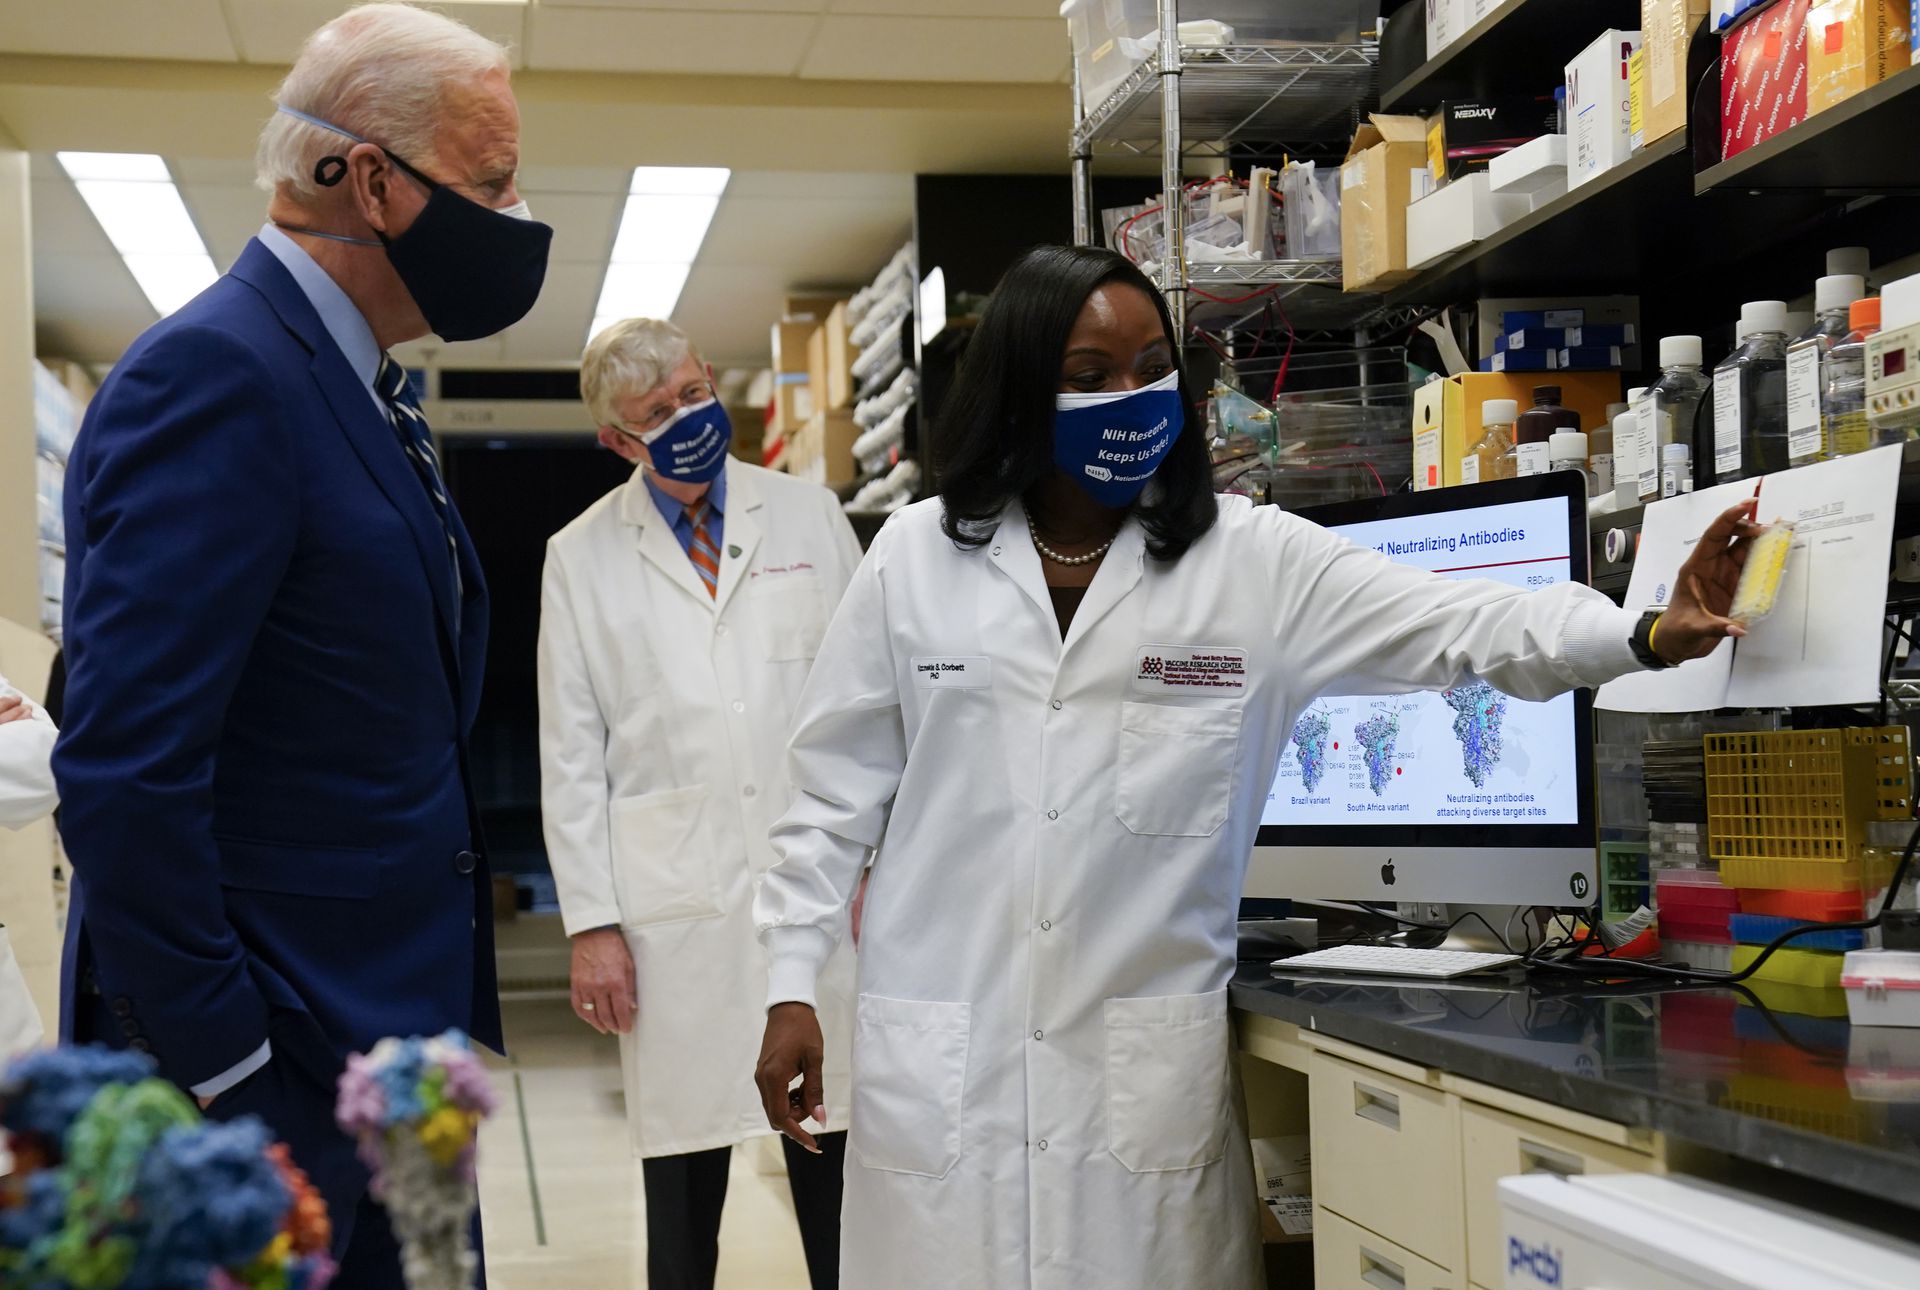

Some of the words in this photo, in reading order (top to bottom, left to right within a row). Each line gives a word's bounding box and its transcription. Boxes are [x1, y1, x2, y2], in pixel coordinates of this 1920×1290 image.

[1788, 62, 1805, 104] QIAGEN
[1736, 100, 1750, 139] QIAGEN
[1767, 94, 1782, 134] QIAGEN
[1102, 428, 1127, 441] NIH
[1129, 416, 1168, 442] Research
[1098, 449, 1136, 464] Keeps
[1137, 450, 1150, 461] Us
[1150, 434, 1169, 456] Safe!
[1087, 468, 1105, 478] NIH
[1388, 536, 1456, 555] Neutralizing
[1460, 528, 1526, 548] Antibodies
[1527, 575, 1555, 586] RBD-up
[941, 662, 965, 672] Corbett
[1292, 796, 1308, 805] Brazil
[1309, 796, 1330, 805] variant
[1446, 794, 1492, 804] Neutralizing
[1494, 792, 1535, 802] antibodies
[1346, 803, 1366, 812] South
[1367, 803, 1386, 812] Africa
[1387, 804, 1410, 812] variant
[1436, 807, 1471, 818] attacking
[1473, 806, 1500, 816] diverse
[1502, 808, 1526, 818] target
[1528, 806, 1547, 816] sites
[1573, 878, 1586, 895] 19
